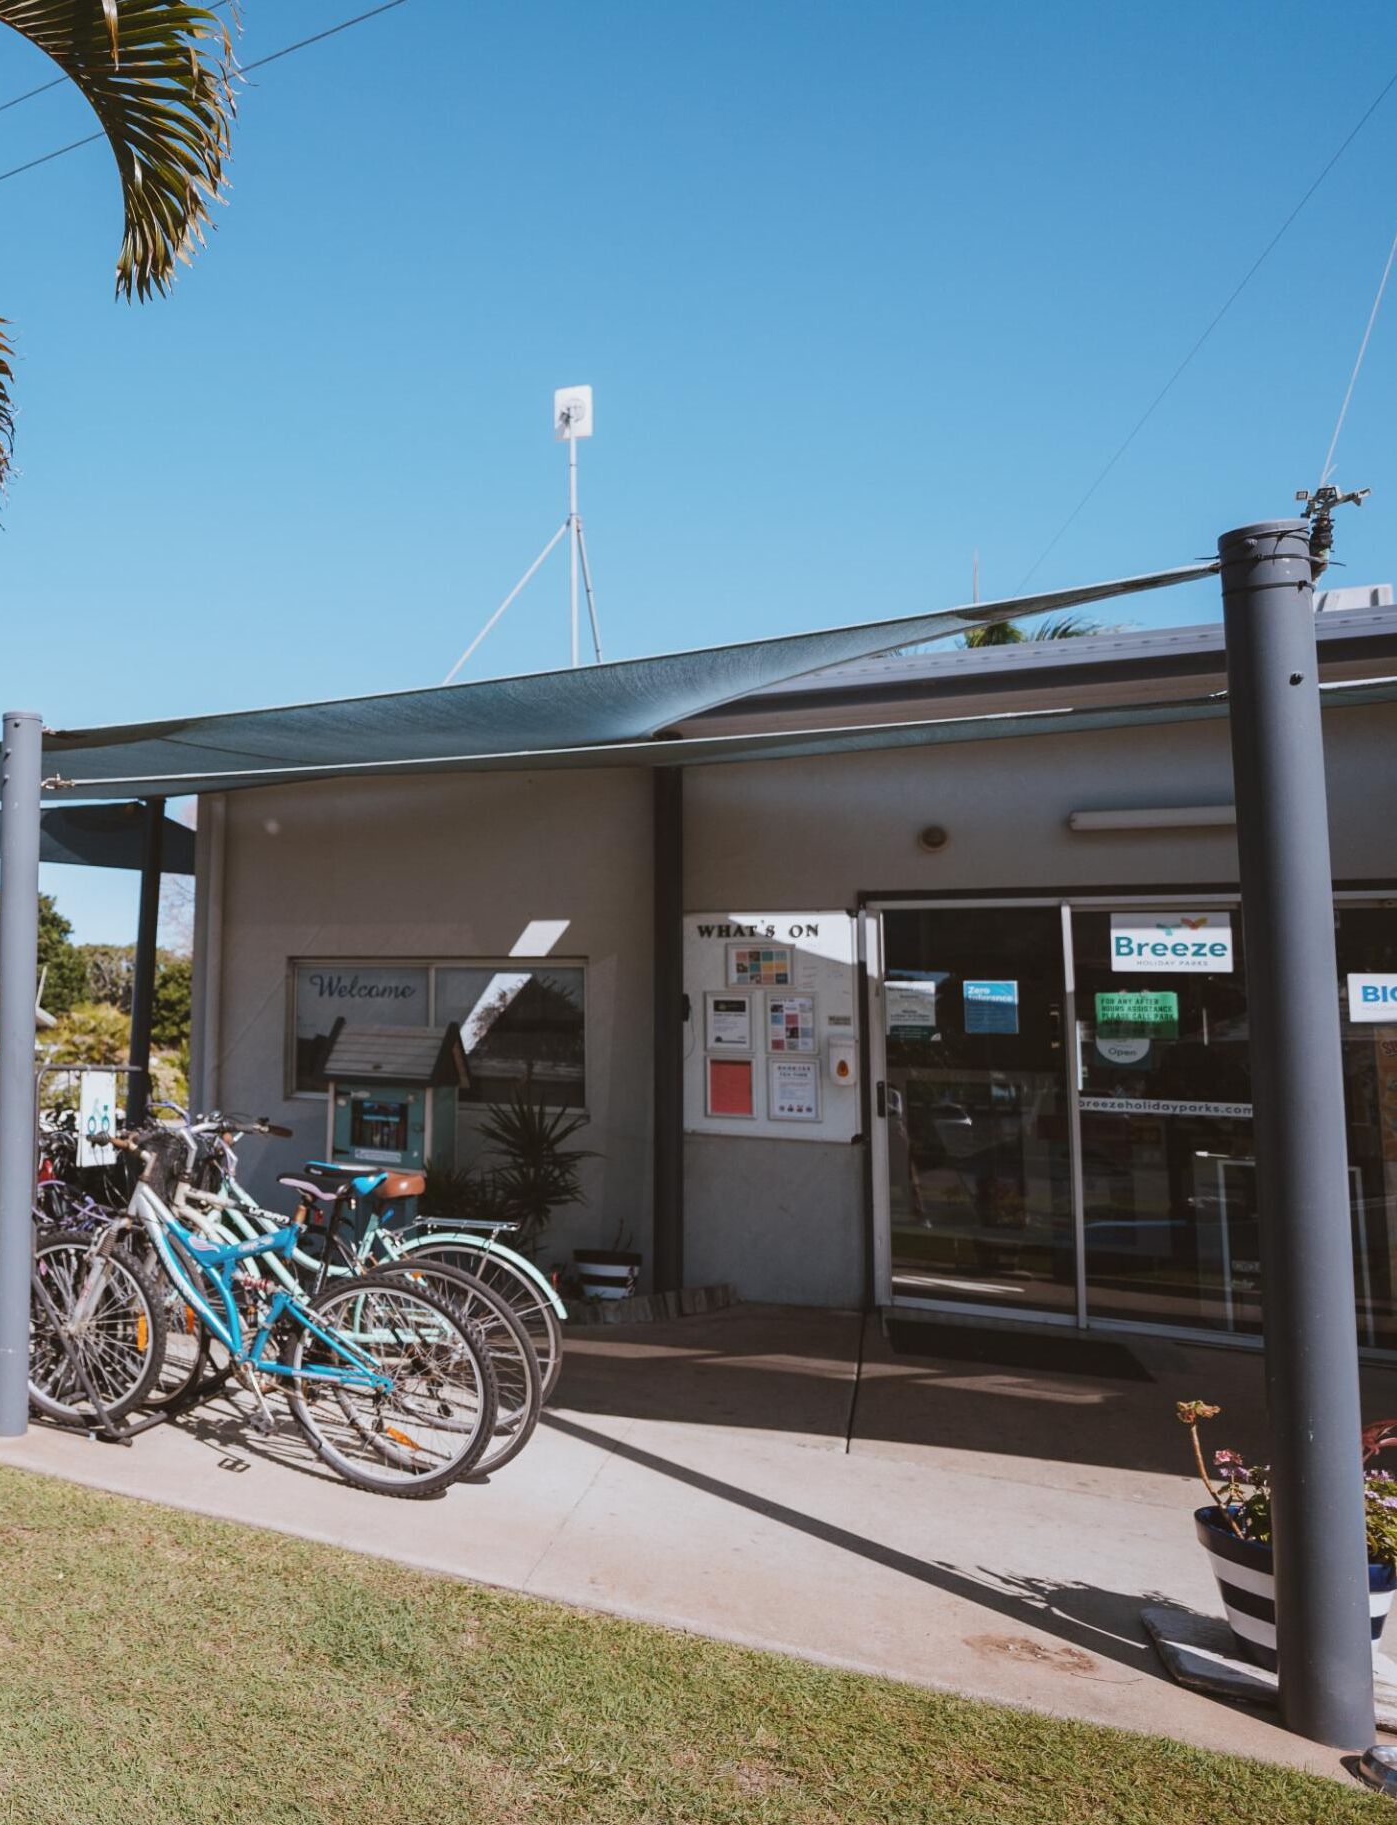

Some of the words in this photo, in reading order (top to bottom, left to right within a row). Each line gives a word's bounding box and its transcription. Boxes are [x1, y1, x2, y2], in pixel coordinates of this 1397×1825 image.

[697, 919, 775, 938] WHAT'S
[789, 924, 819, 938] ON
[1114, 936, 1228, 957] Breeze
[309, 974, 416, 998] Welcome
[967, 986, 991, 995] Zero
[1108, 1048, 1137, 1057] Open
